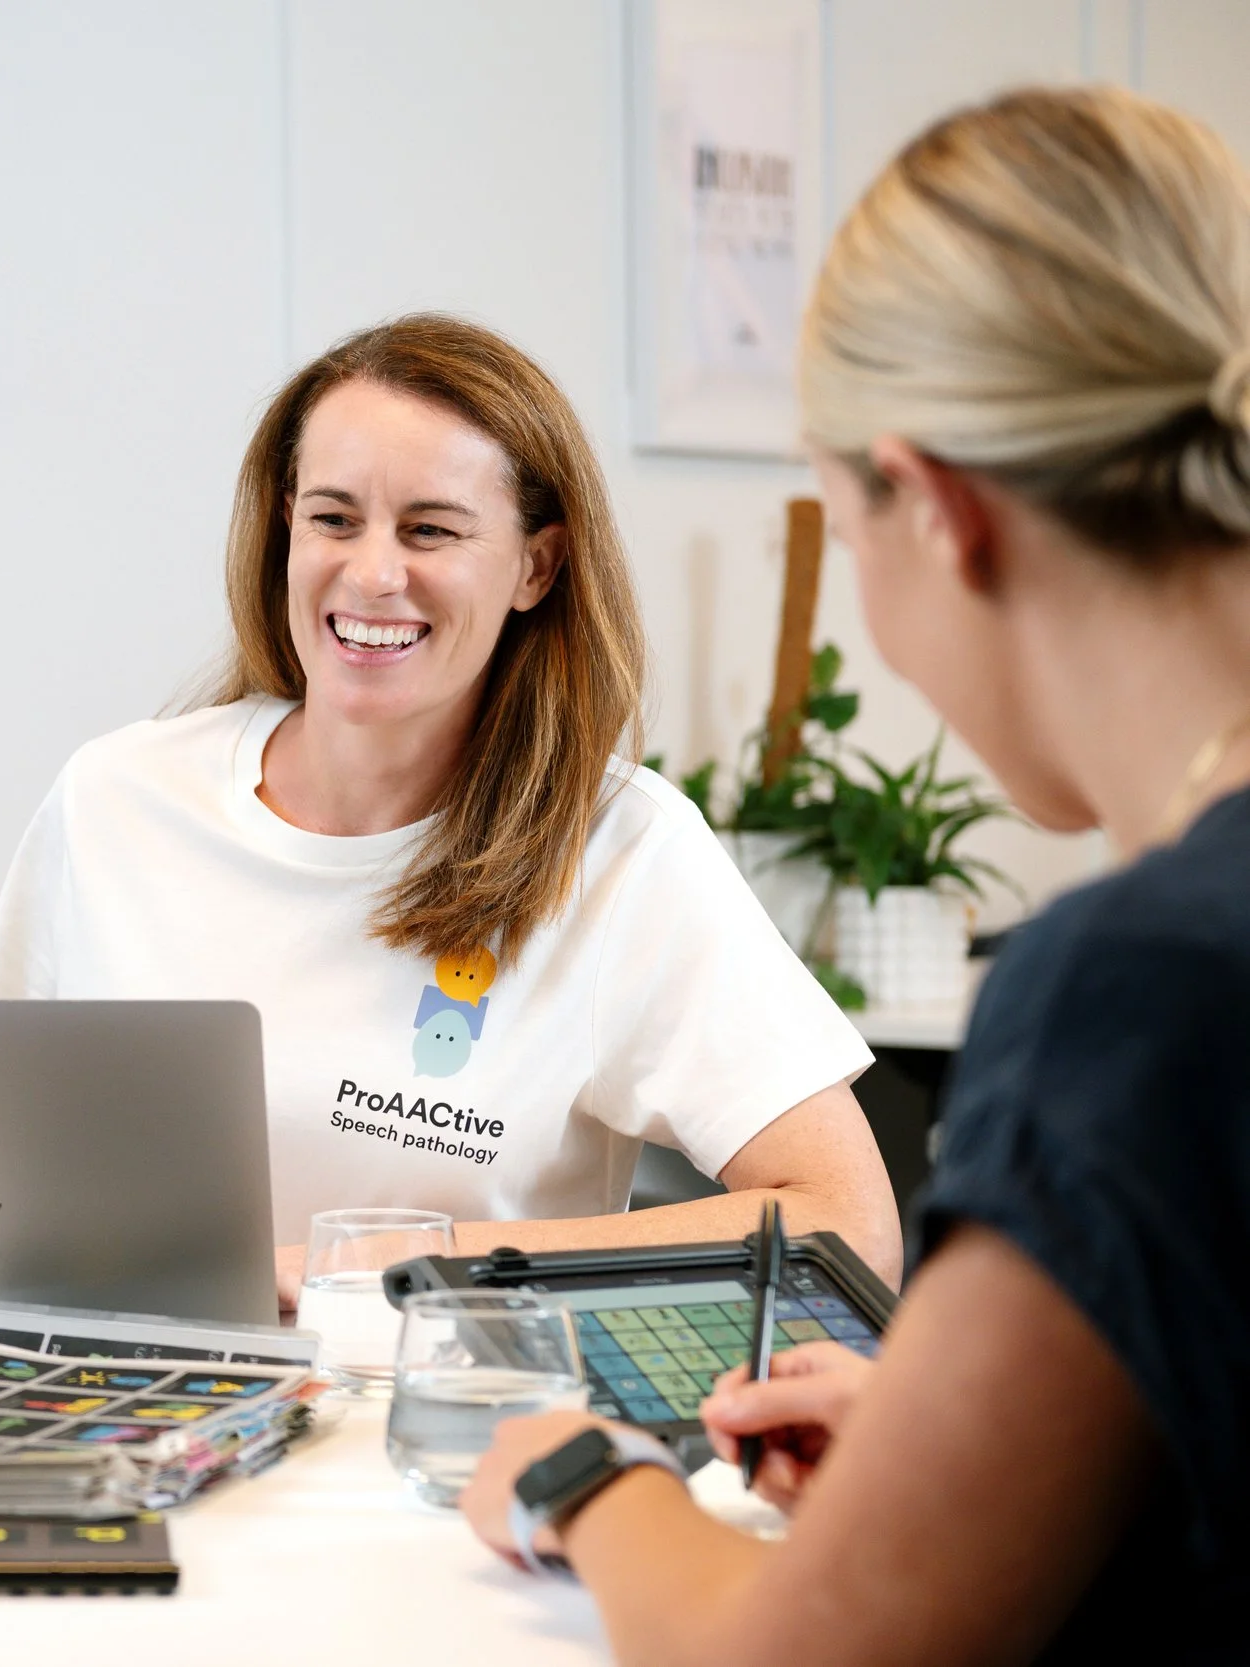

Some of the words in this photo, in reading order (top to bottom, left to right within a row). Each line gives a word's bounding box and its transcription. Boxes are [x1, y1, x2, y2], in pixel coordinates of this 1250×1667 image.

[336, 1079, 505, 1138] ProAACtive
[330, 1110, 398, 1142] Speech
[402, 1133, 499, 1166] pathology
